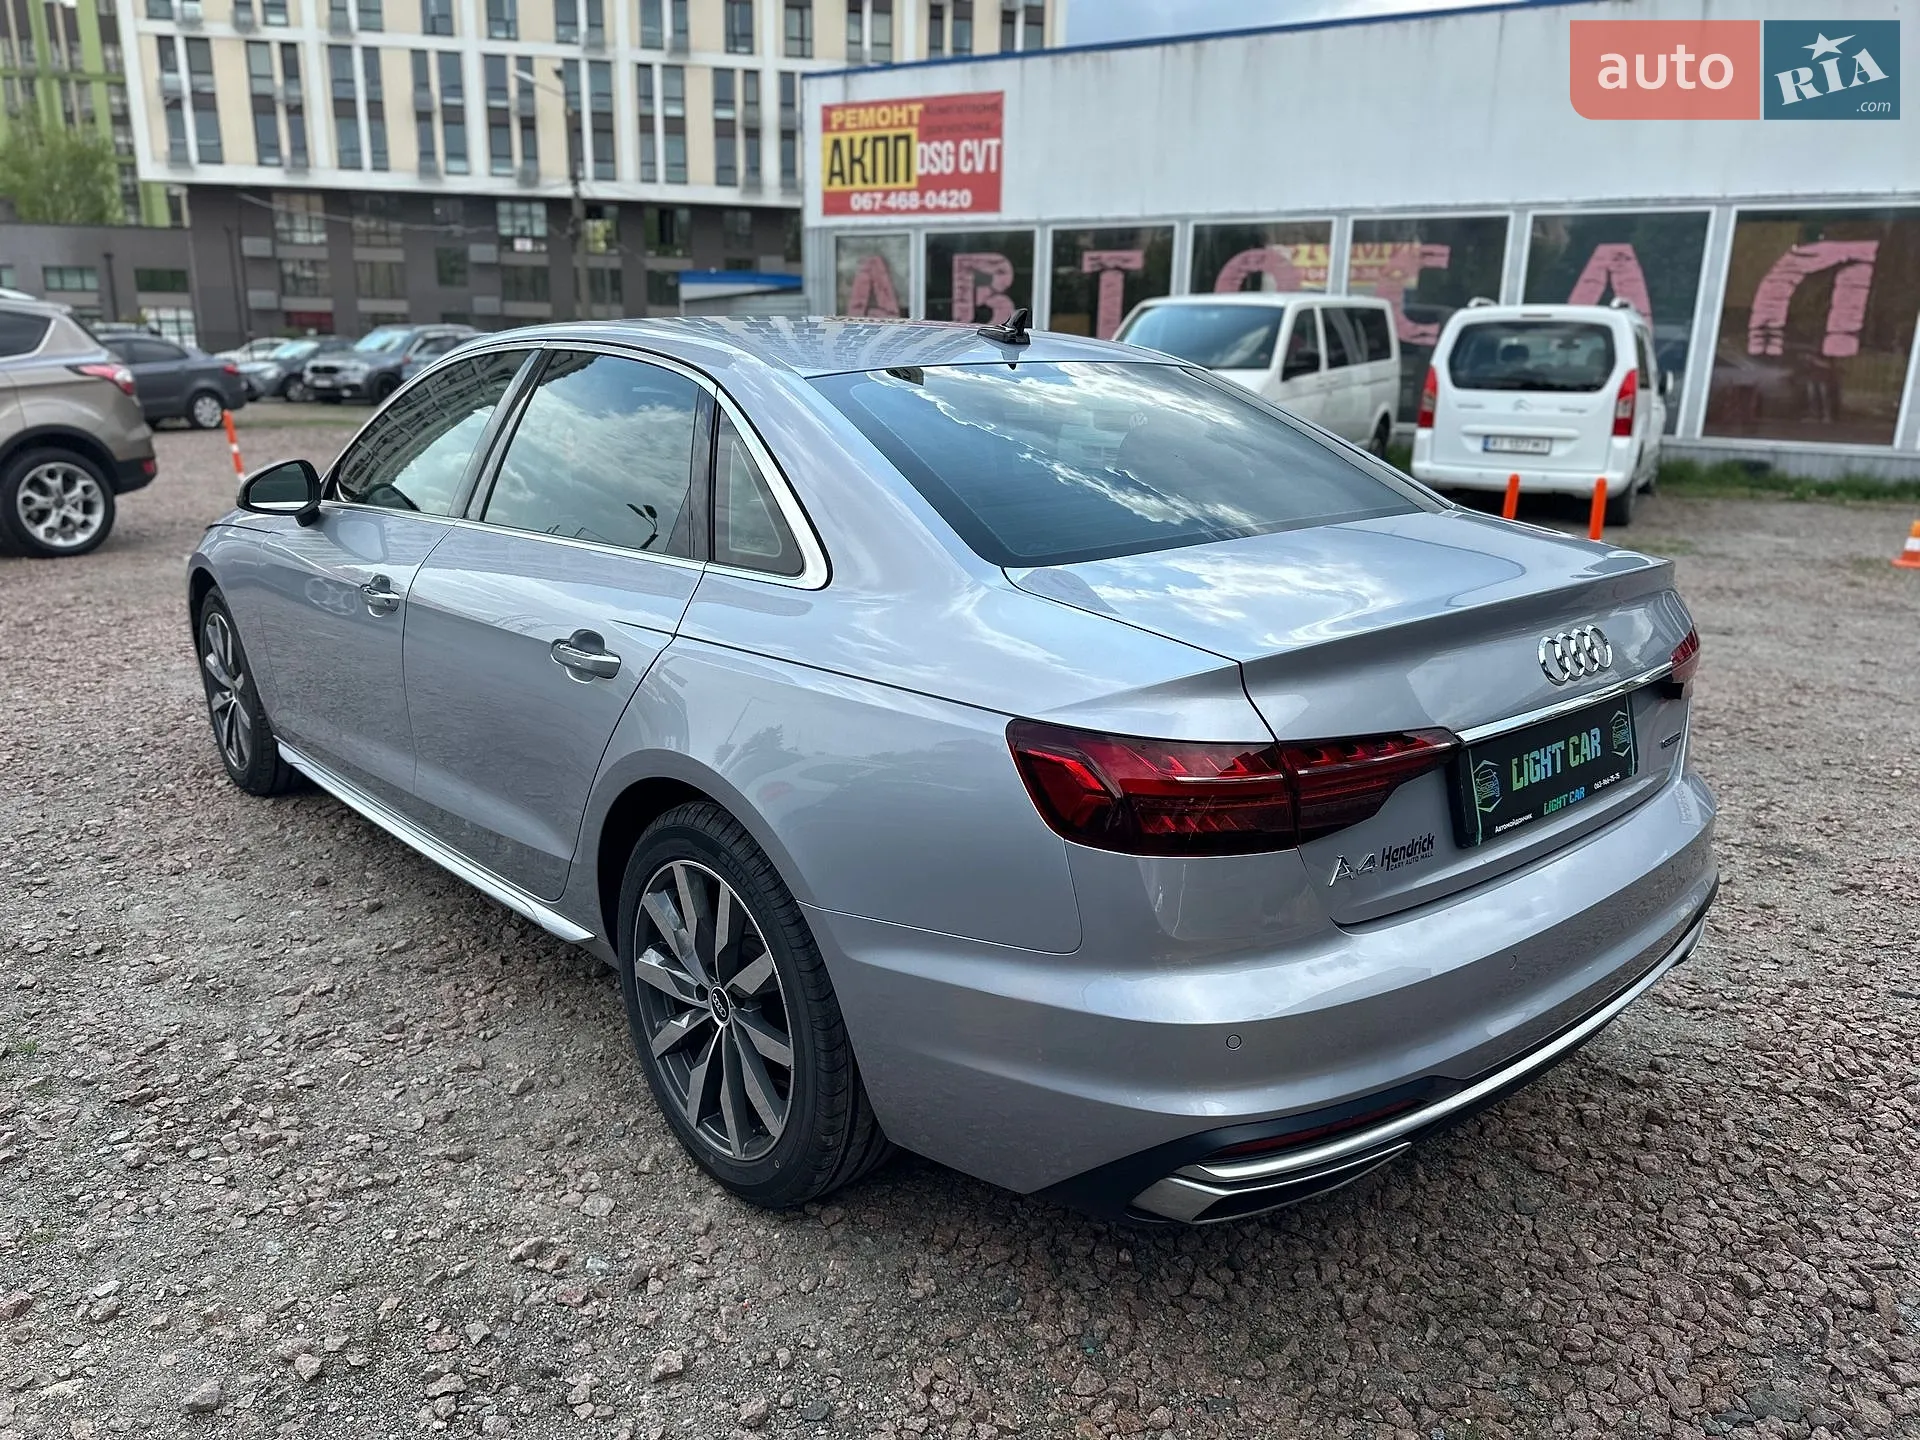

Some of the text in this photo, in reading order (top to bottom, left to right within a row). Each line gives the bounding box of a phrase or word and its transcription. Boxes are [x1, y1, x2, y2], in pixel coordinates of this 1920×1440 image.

[830, 103, 924, 130] РЕМОНТ
[828, 134, 1001, 186] АКПП DSG CVT
[850, 189, 972, 211] 067-468-0420
[1511, 727, 1601, 791] LIGHT CAR
[1543, 786, 1585, 816] LIGHT CAR
[1381, 832, 1435, 872] Hendrick
[1406, 855, 1419, 865] AUTO
[1328, 853, 1379, 887] A4
